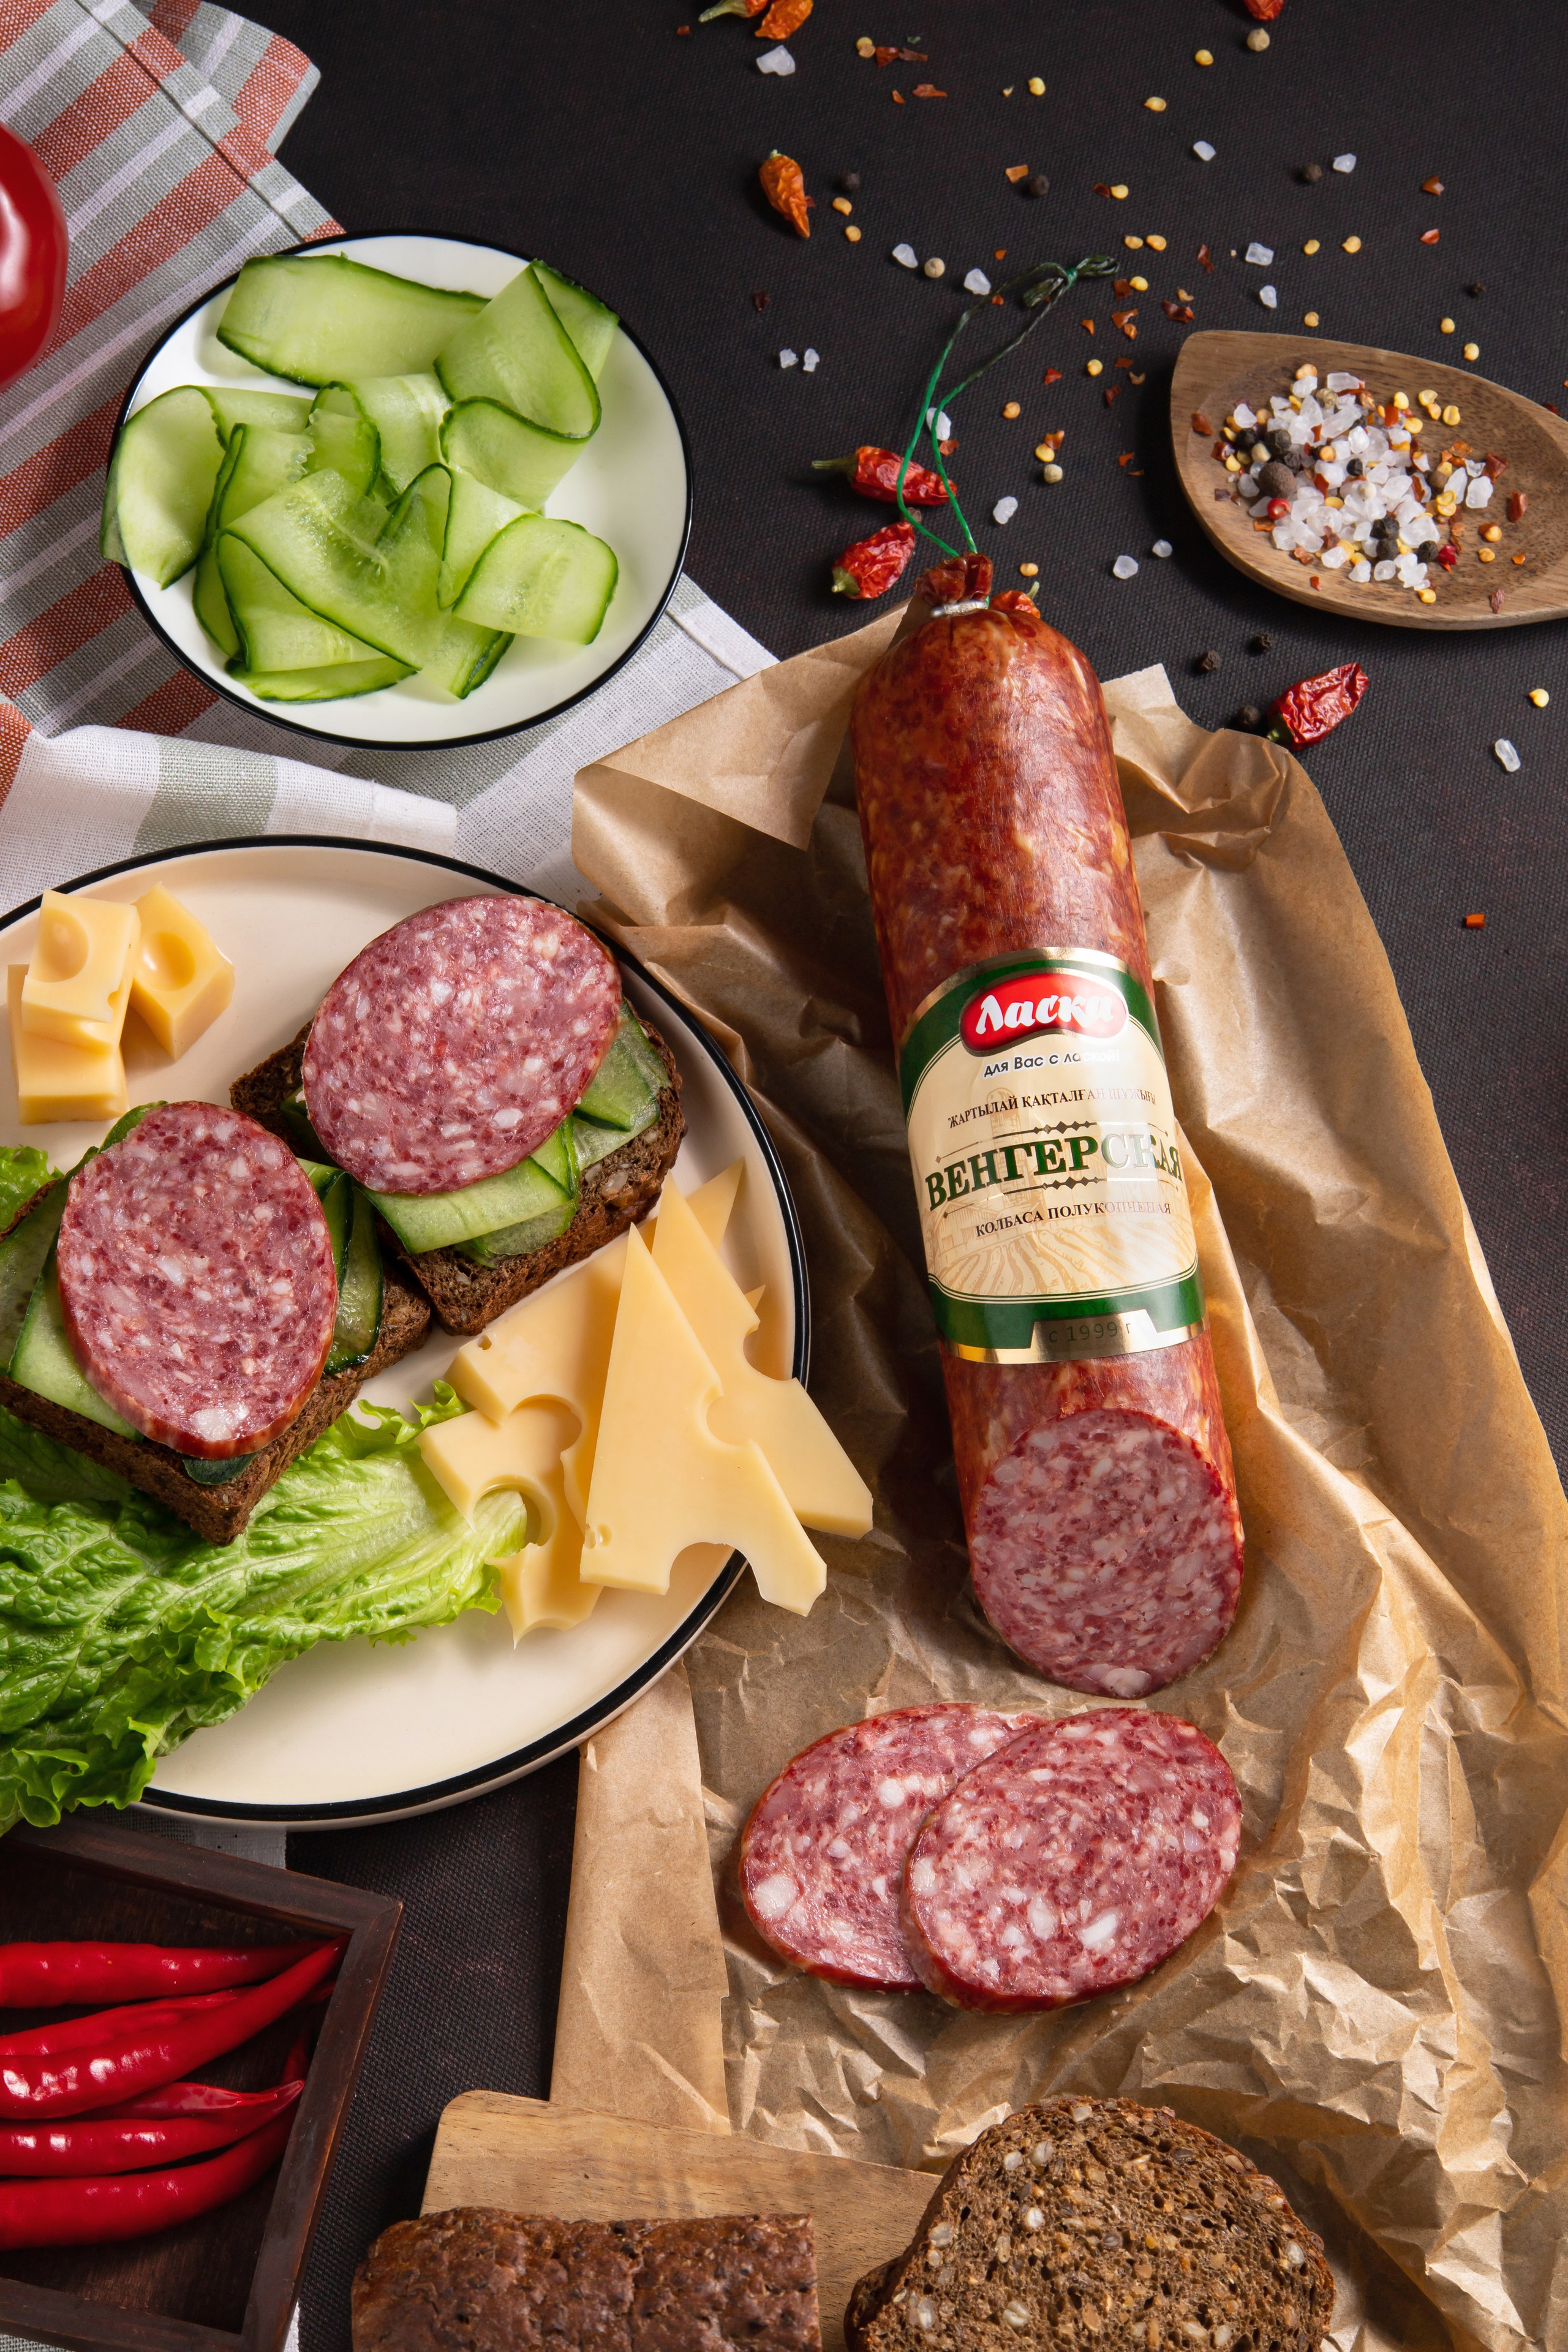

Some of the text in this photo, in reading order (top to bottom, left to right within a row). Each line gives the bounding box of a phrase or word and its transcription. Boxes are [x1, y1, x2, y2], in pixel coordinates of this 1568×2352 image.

[975, 995, 1115, 1035] Ласка
[984, 1061, 1009, 1078] для
[1014, 1056, 1044, 1069] Вас
[1049, 1054, 1058, 1065] с
[948, 1095, 1019, 1129] ЖАРТЫЛАЙ
[1021, 1088, 1105, 1109] ҚАҚТАЛҒАН
[925, 1133, 1183, 1211] ВЕНГЕРСКАЯ
[976, 1200, 1171, 1237] КОЛБАСА ПОЛУКОПЧЕНАЯ
[1066, 1321, 1118, 1341] 1999
